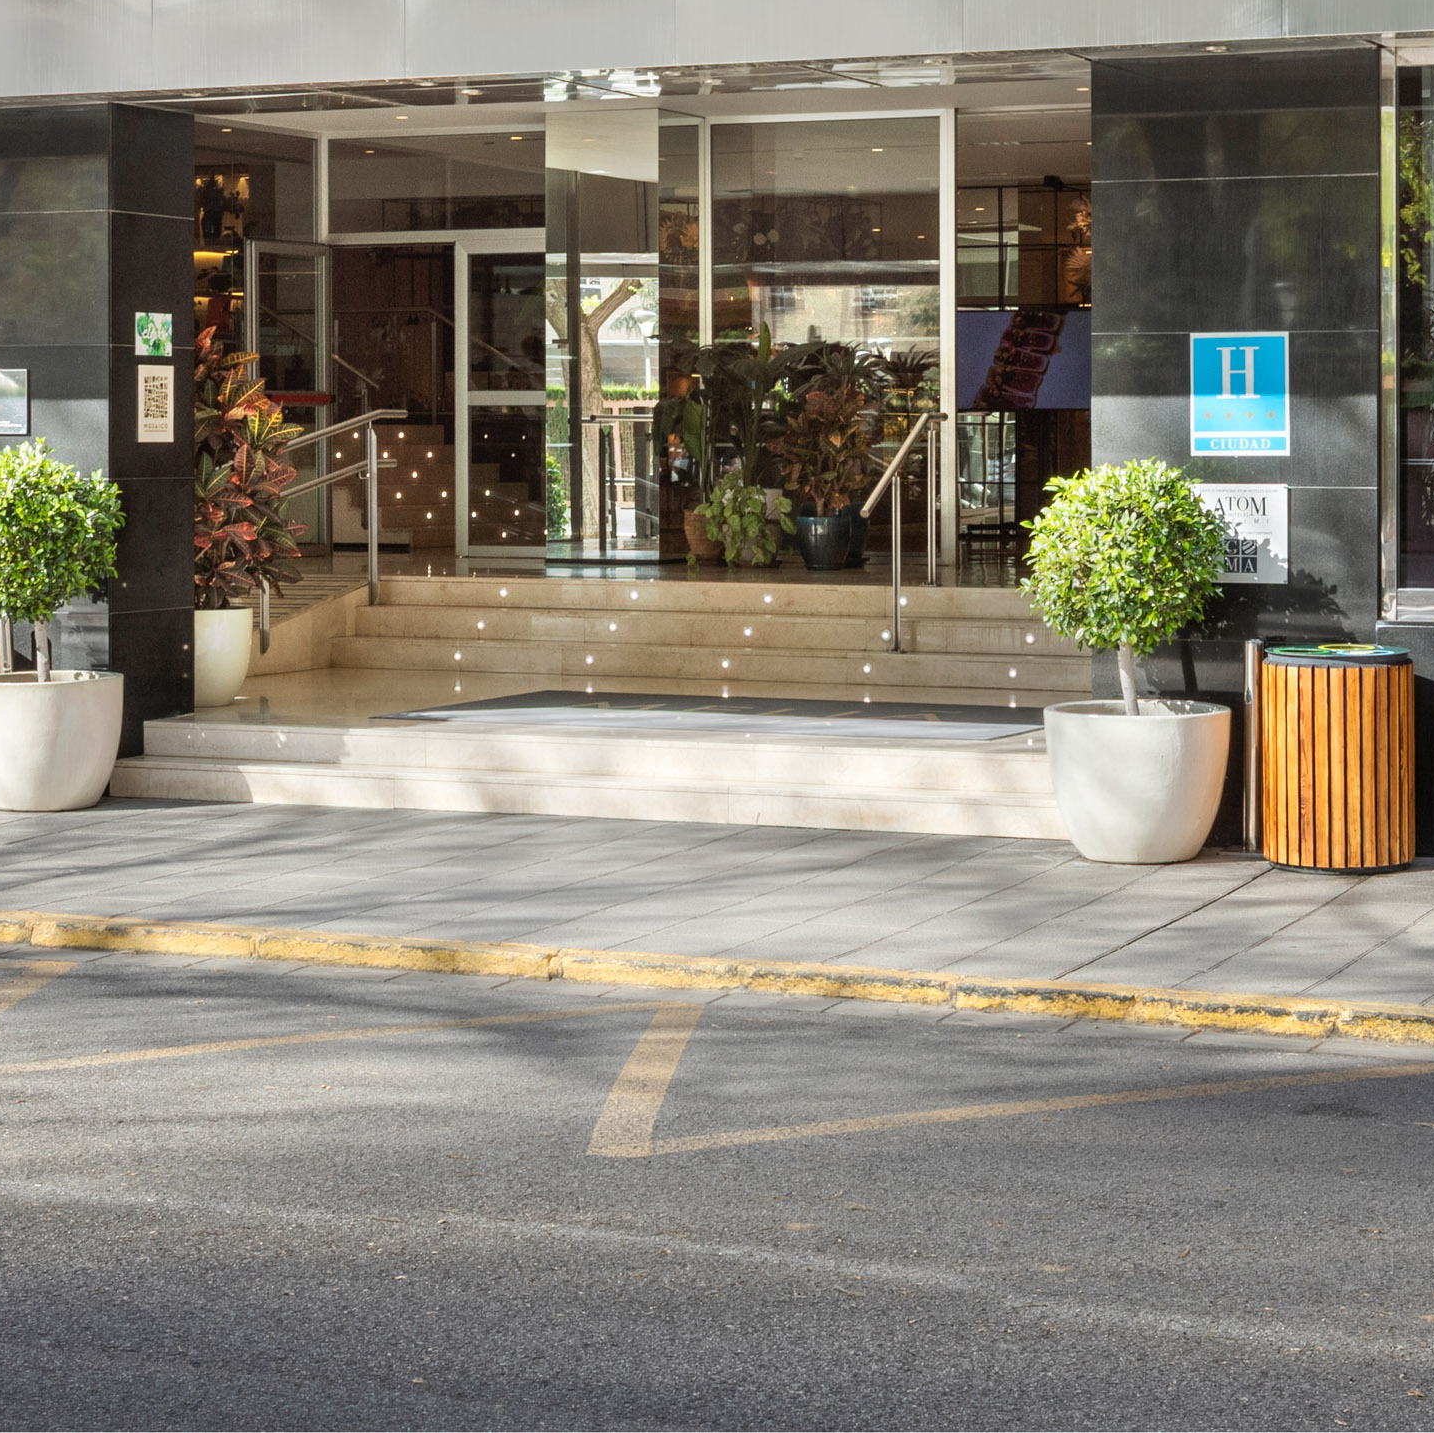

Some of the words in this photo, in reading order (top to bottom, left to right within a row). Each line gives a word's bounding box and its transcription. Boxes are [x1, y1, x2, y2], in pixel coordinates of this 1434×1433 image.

[1215, 346, 1260, 399] H
[1210, 438, 1271, 451] CIUDAD
[1214, 496, 1267, 516] ATOM
